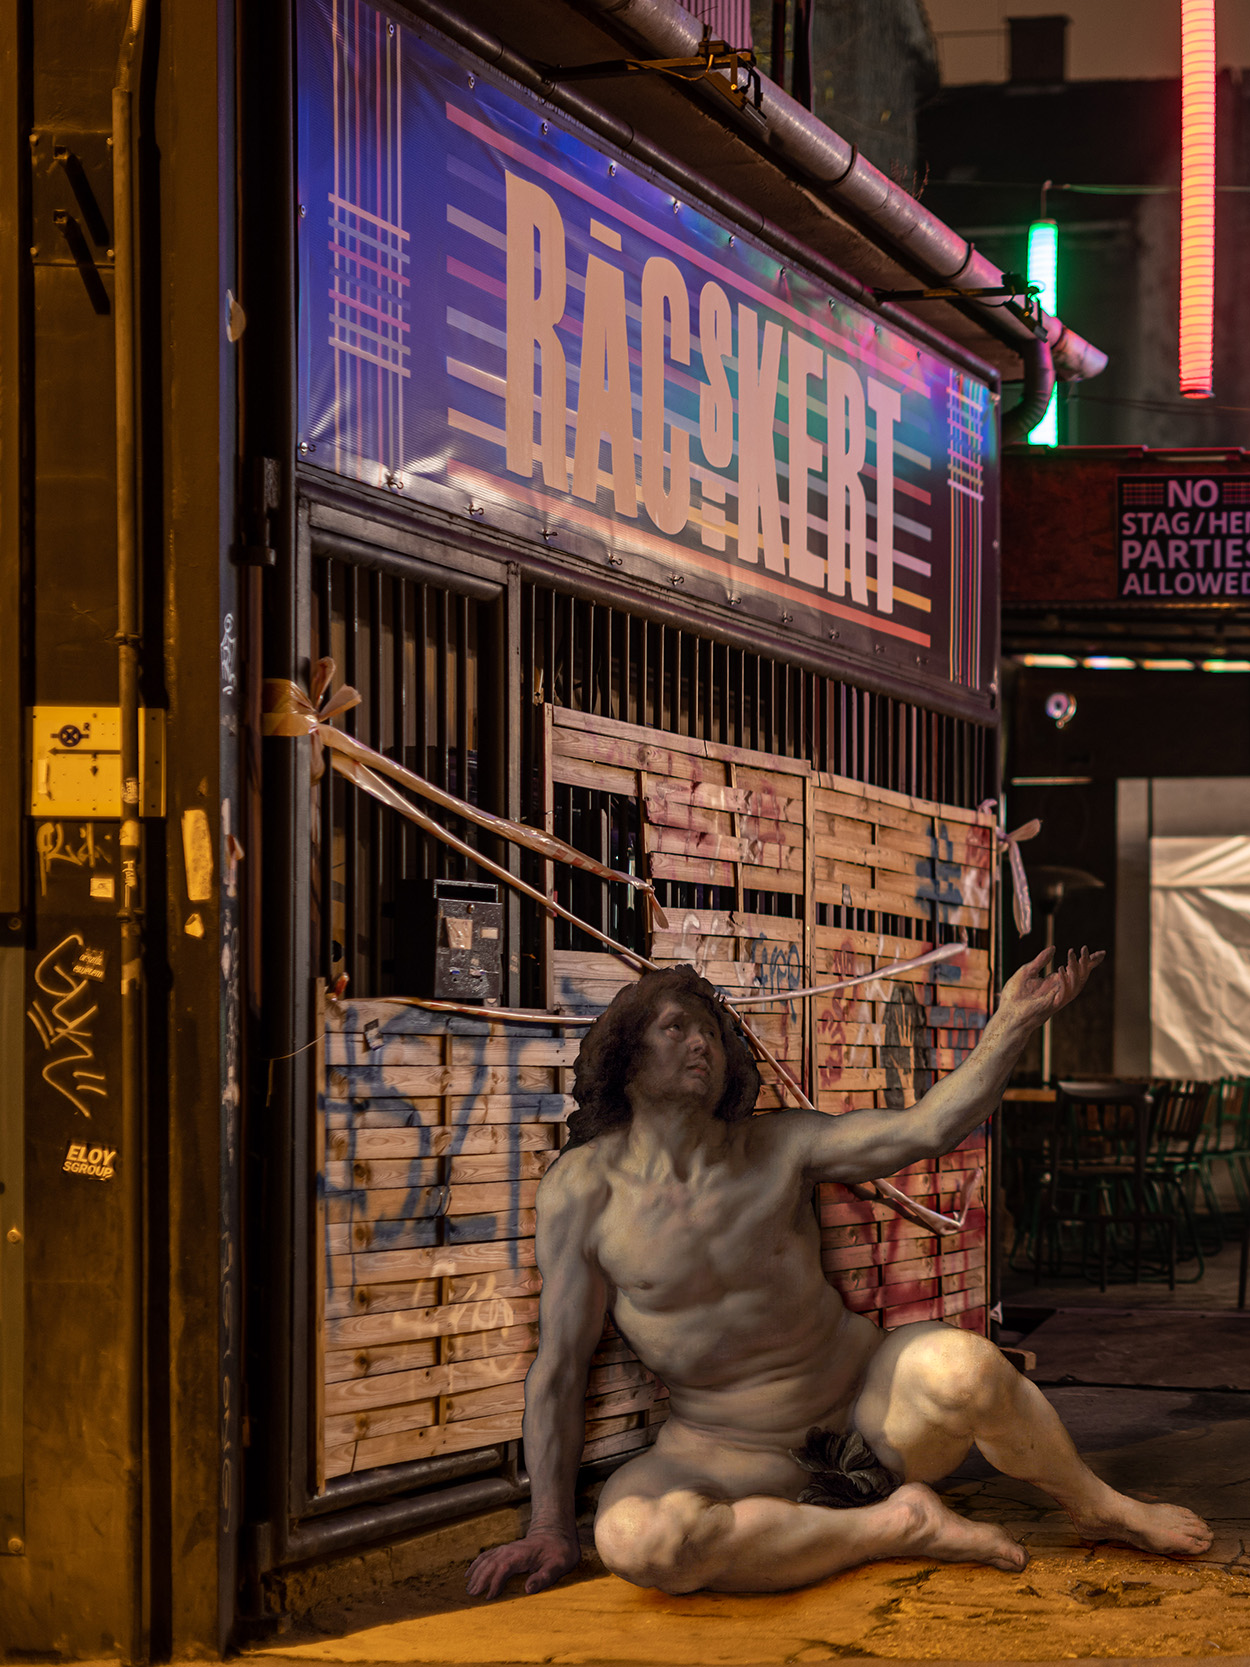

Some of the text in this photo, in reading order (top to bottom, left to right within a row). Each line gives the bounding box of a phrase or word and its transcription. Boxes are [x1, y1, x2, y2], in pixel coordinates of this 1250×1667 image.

[1167, 479, 1219, 507] NO
[66, 1144, 116, 1166] ELOY
[62, 1161, 113, 1177] SGROUP
